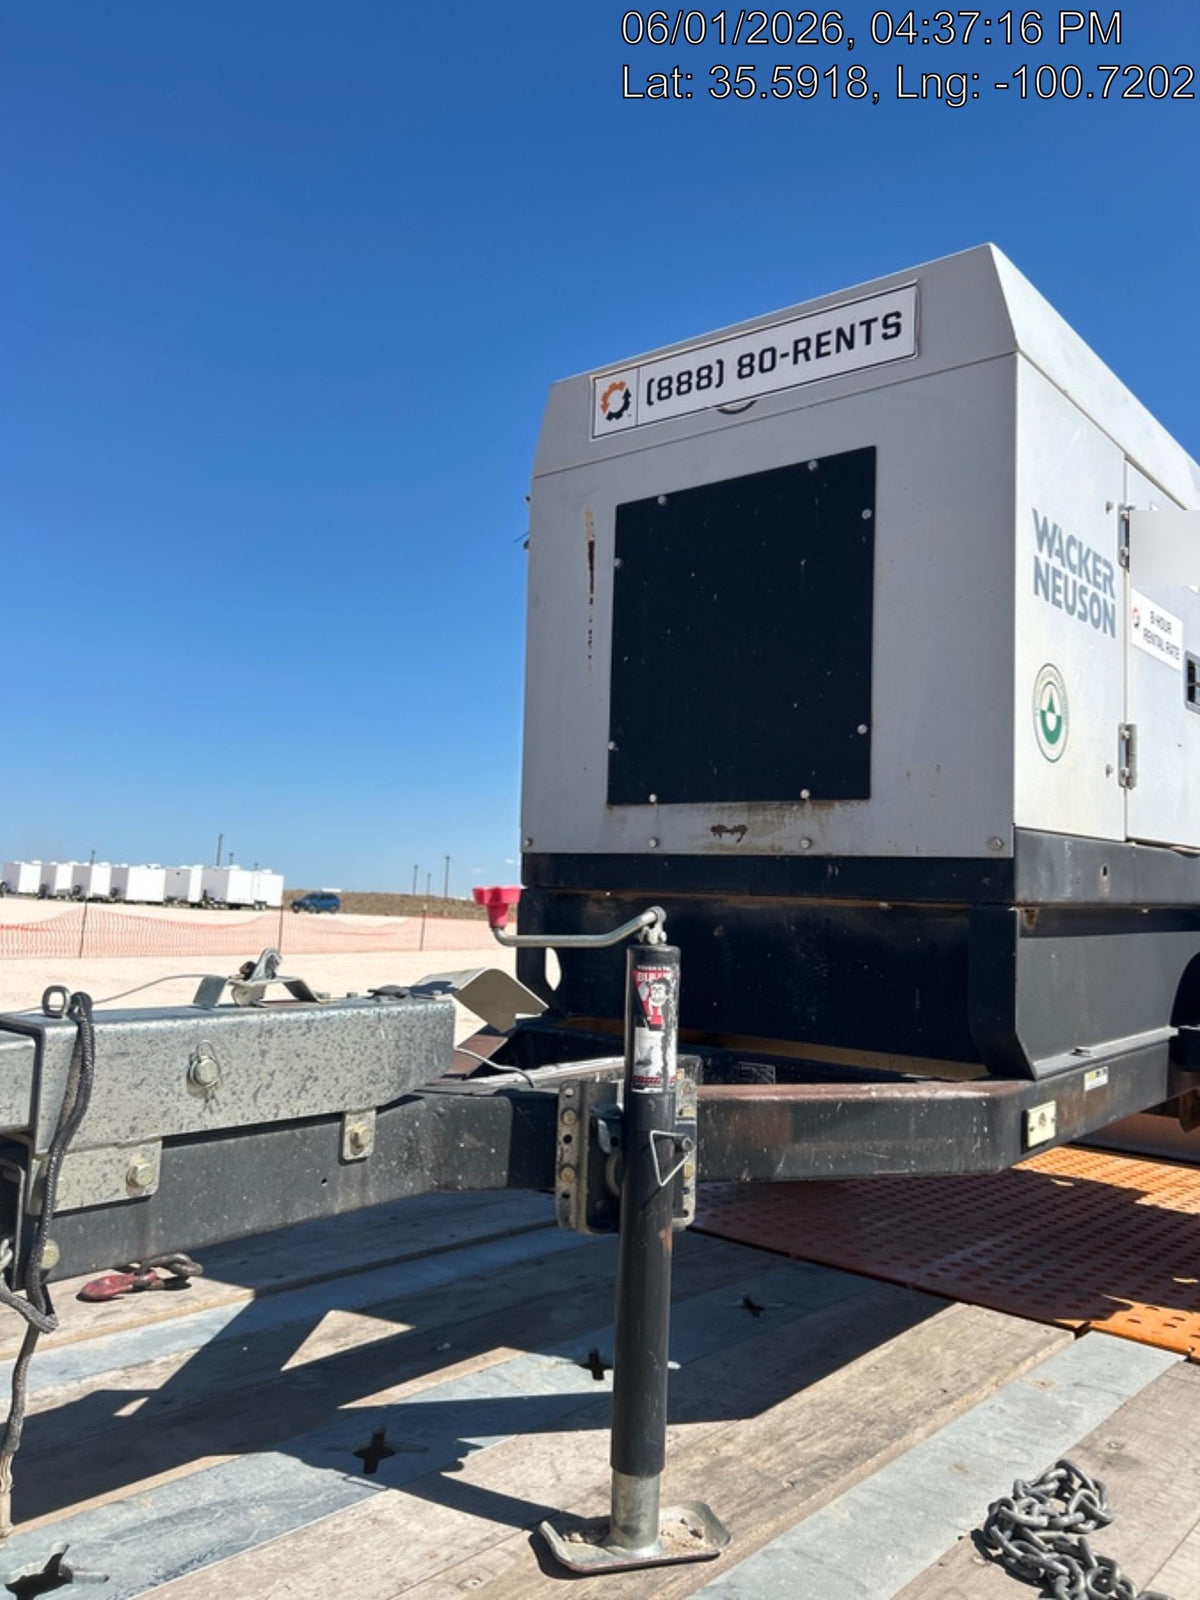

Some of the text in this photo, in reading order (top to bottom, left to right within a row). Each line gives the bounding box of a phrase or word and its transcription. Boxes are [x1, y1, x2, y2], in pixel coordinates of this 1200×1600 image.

[646, 310, 902, 407] (888) 80-RENTS
[1032, 507, 1115, 600] WACKER
[1034, 554, 1116, 639] NEUSON
